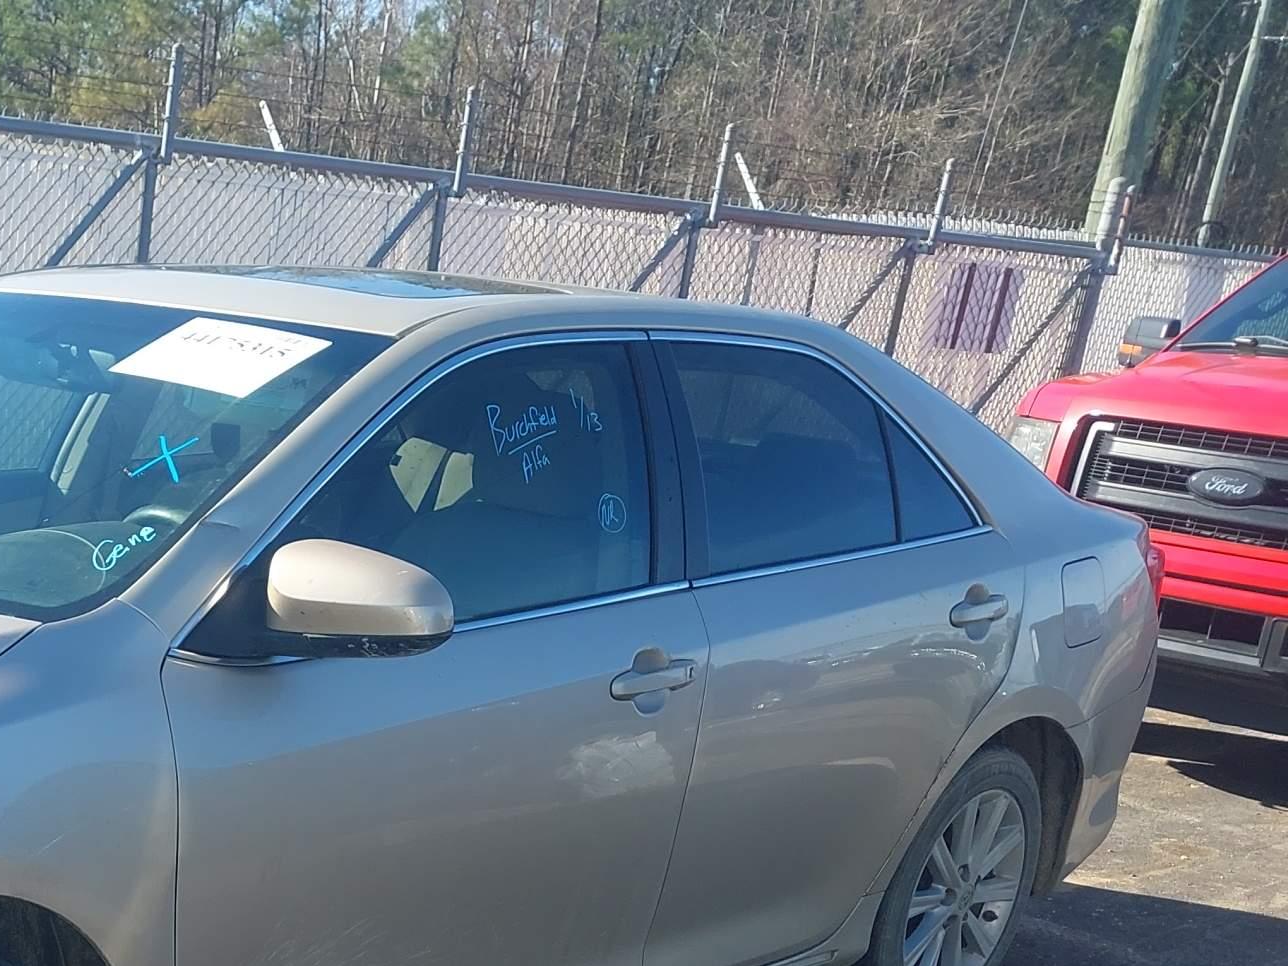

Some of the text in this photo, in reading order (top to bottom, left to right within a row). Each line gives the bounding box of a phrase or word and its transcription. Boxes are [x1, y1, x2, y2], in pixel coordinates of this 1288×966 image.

[485, 404, 557, 456] Burchfield
[521, 444, 551, 484] Alfa
[1204, 475, 1249, 495] Ford
[92, 526, 157, 571] Gene
